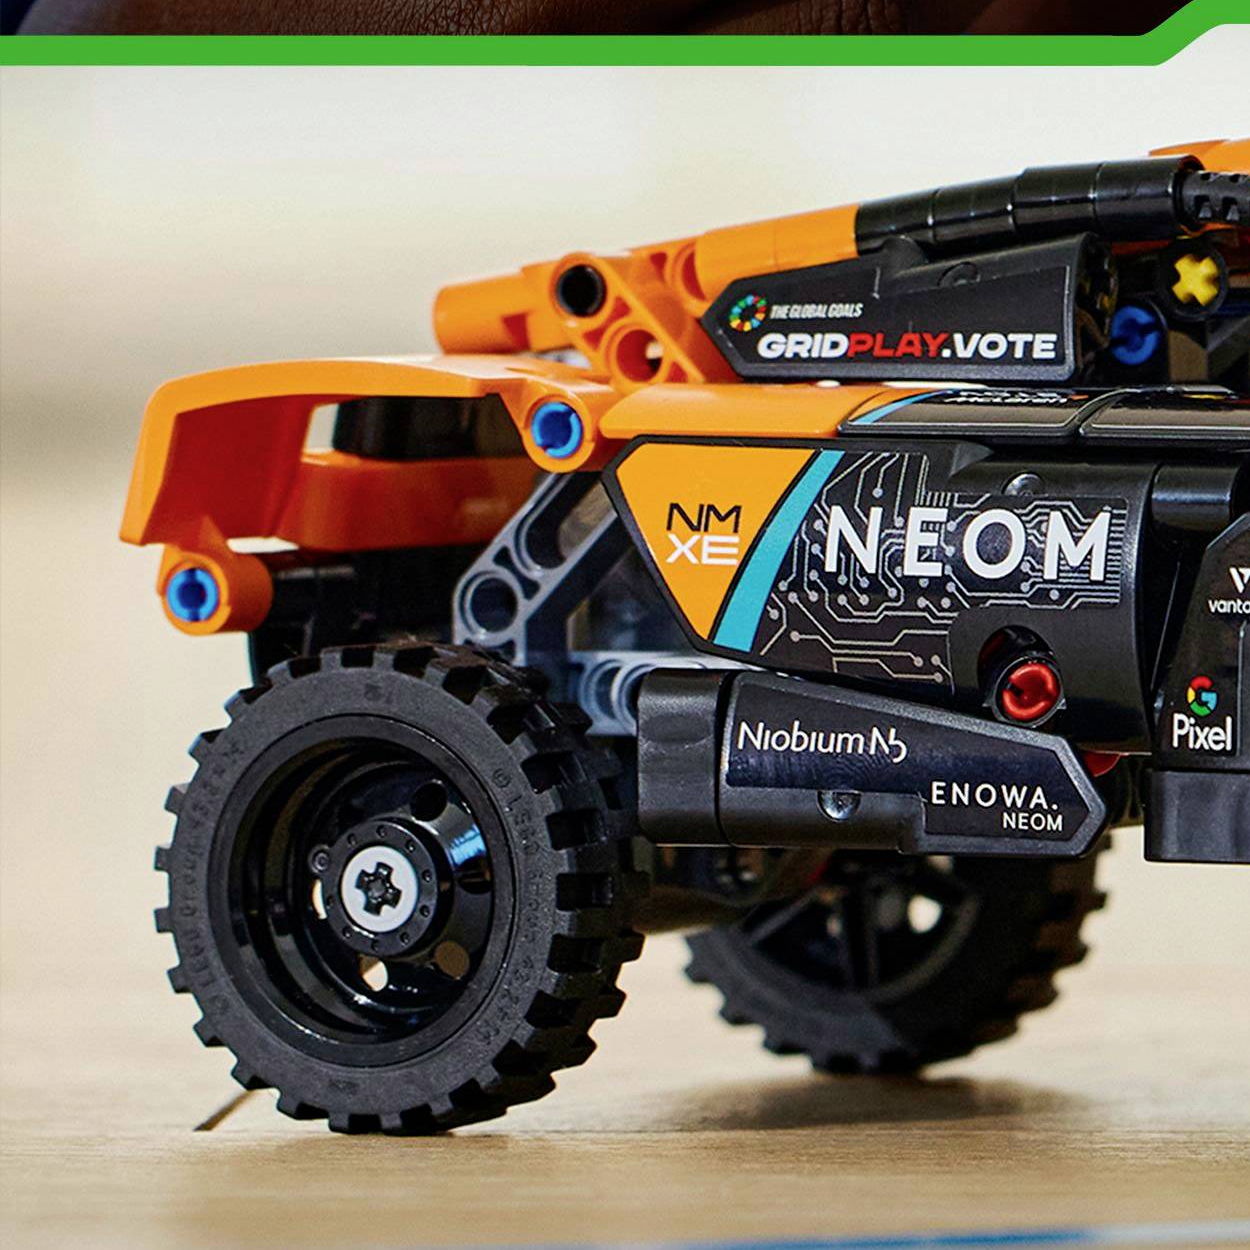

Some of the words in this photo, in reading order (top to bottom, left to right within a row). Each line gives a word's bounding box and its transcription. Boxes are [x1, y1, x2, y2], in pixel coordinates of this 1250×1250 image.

[769, 304, 790, 319] THE
[789, 303, 828, 319] GLOBAL
[828, 302, 864, 318] GOALS
[757, 332, 1058, 359] GRIDPLAY.VOTE
[666, 502, 742, 534] NM
[666, 533, 741, 566] XE
[824, 504, 1112, 582] NEOM
[737, 719, 865, 755] Niobium
[1172, 713, 1233, 751] Pixel
[931, 781, 1059, 811] ENOWA.
[1002, 812, 1064, 832] NEOM
